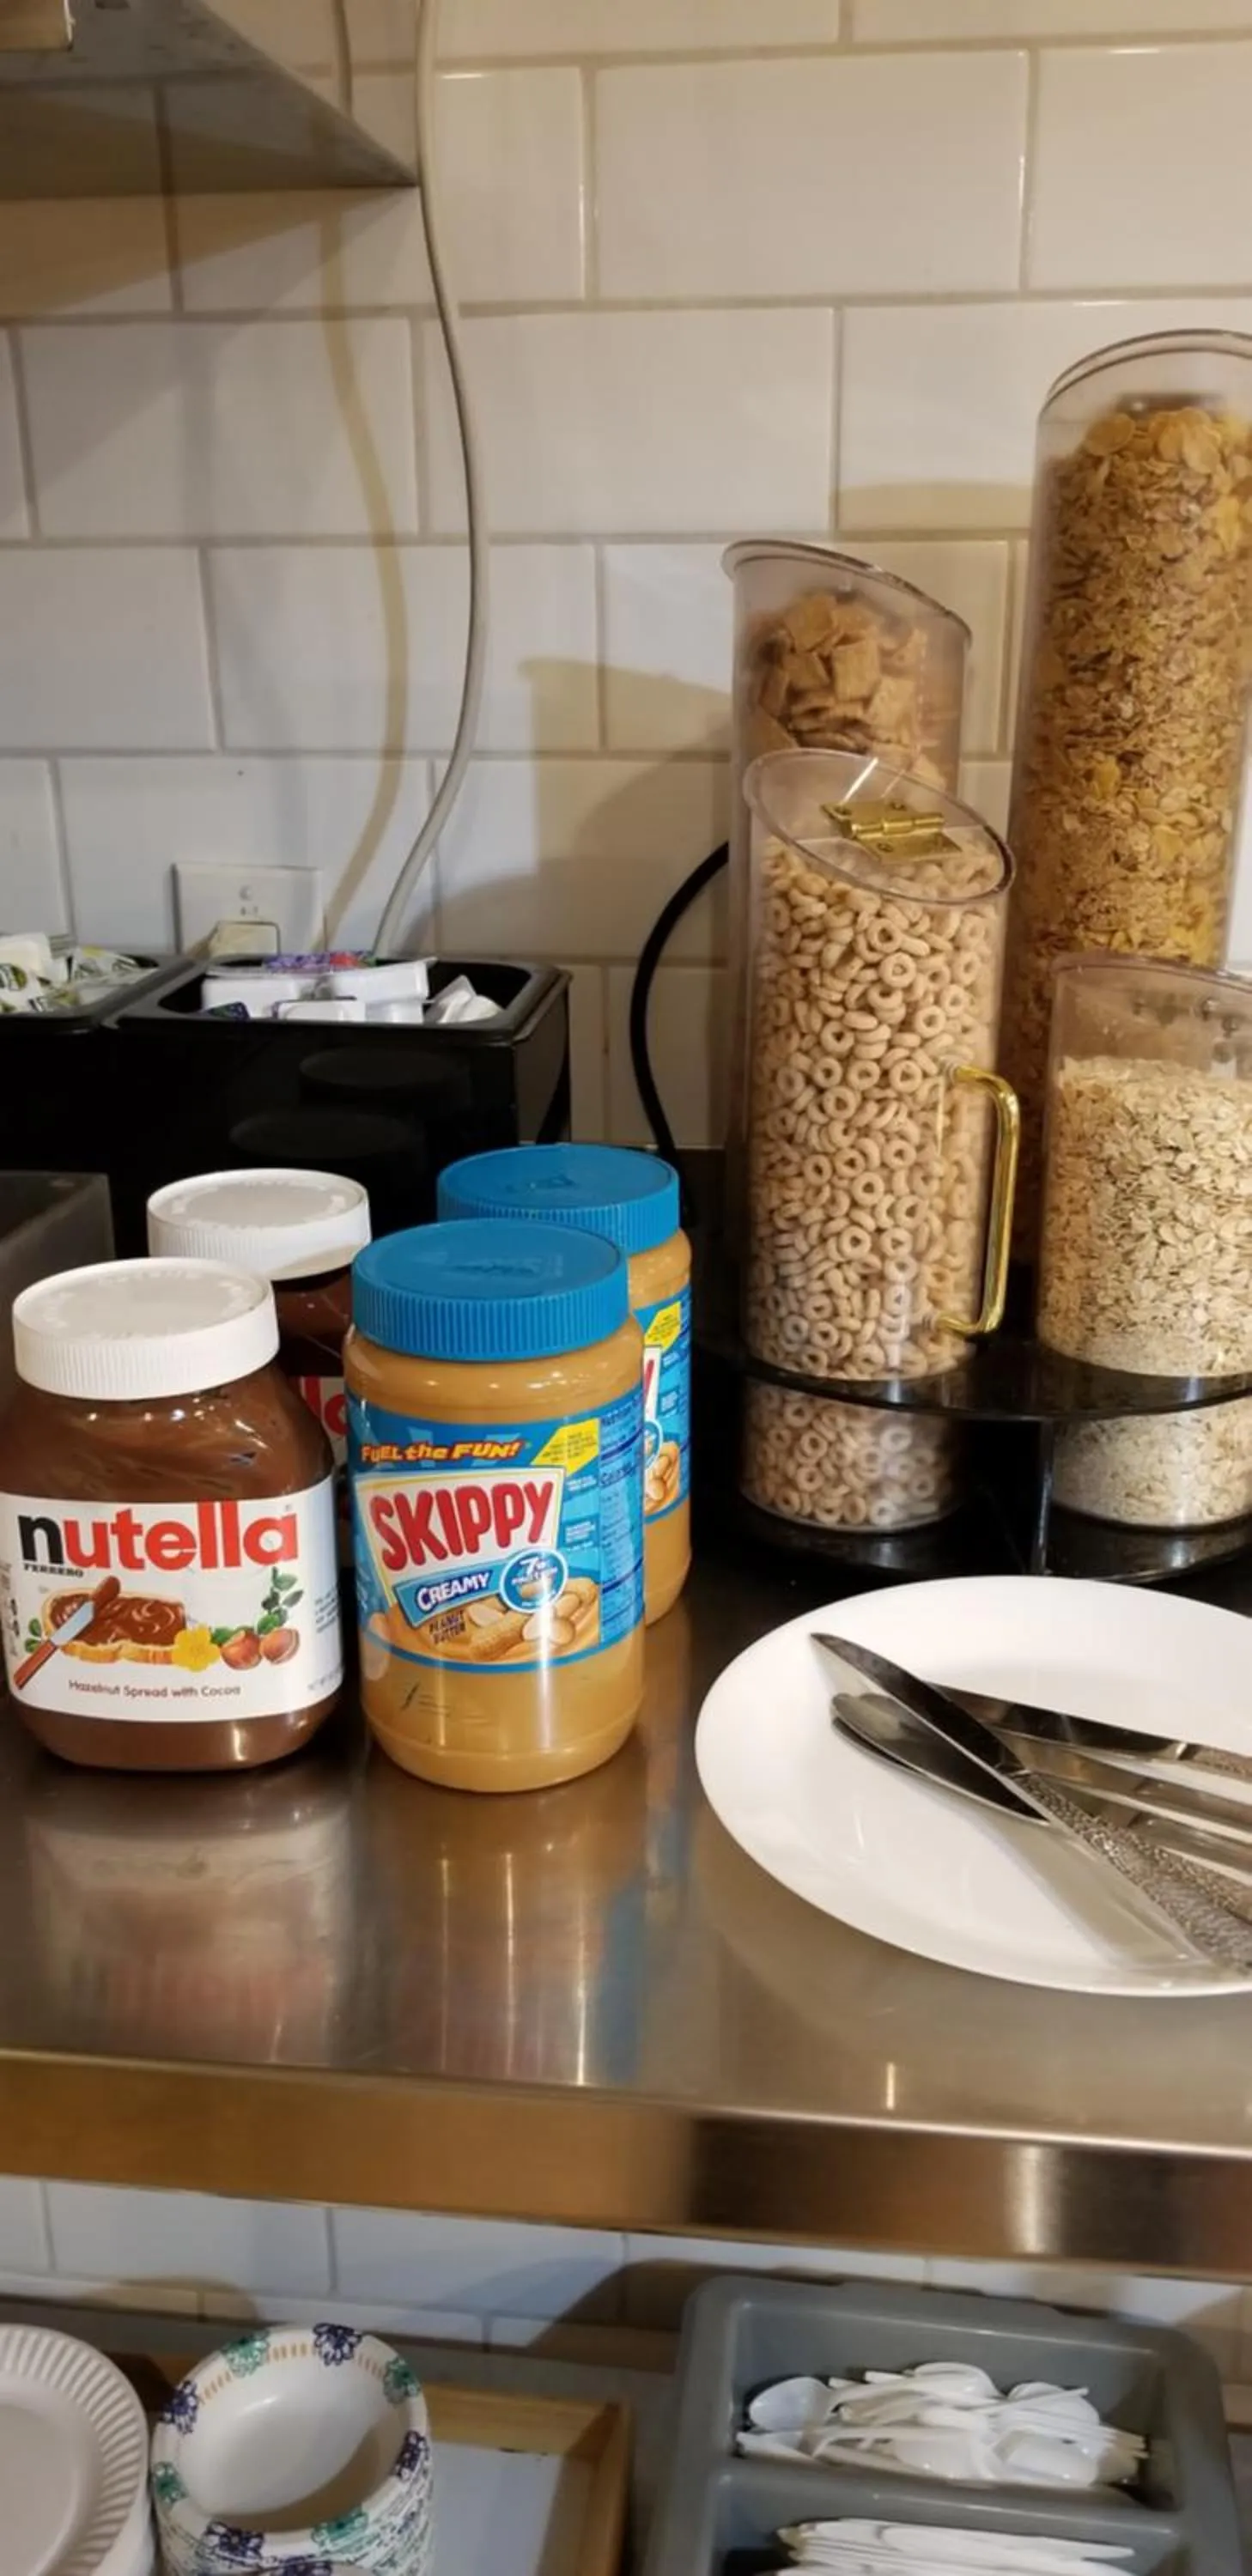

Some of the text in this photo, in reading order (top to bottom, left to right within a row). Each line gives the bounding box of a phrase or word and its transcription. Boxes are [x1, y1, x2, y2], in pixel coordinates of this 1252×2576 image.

[360, 1443, 403, 1463] FUEL
[404, 1442, 448, 1461] the
[451, 1440, 523, 1460] FUN!
[17, 1499, 299, 1571] nutella
[368, 1480, 554, 1571] SKIPPY
[417, 1571, 490, 1612] CREAMY
[68, 1679, 241, 1698] Hazelnut Spread with Cocoa
